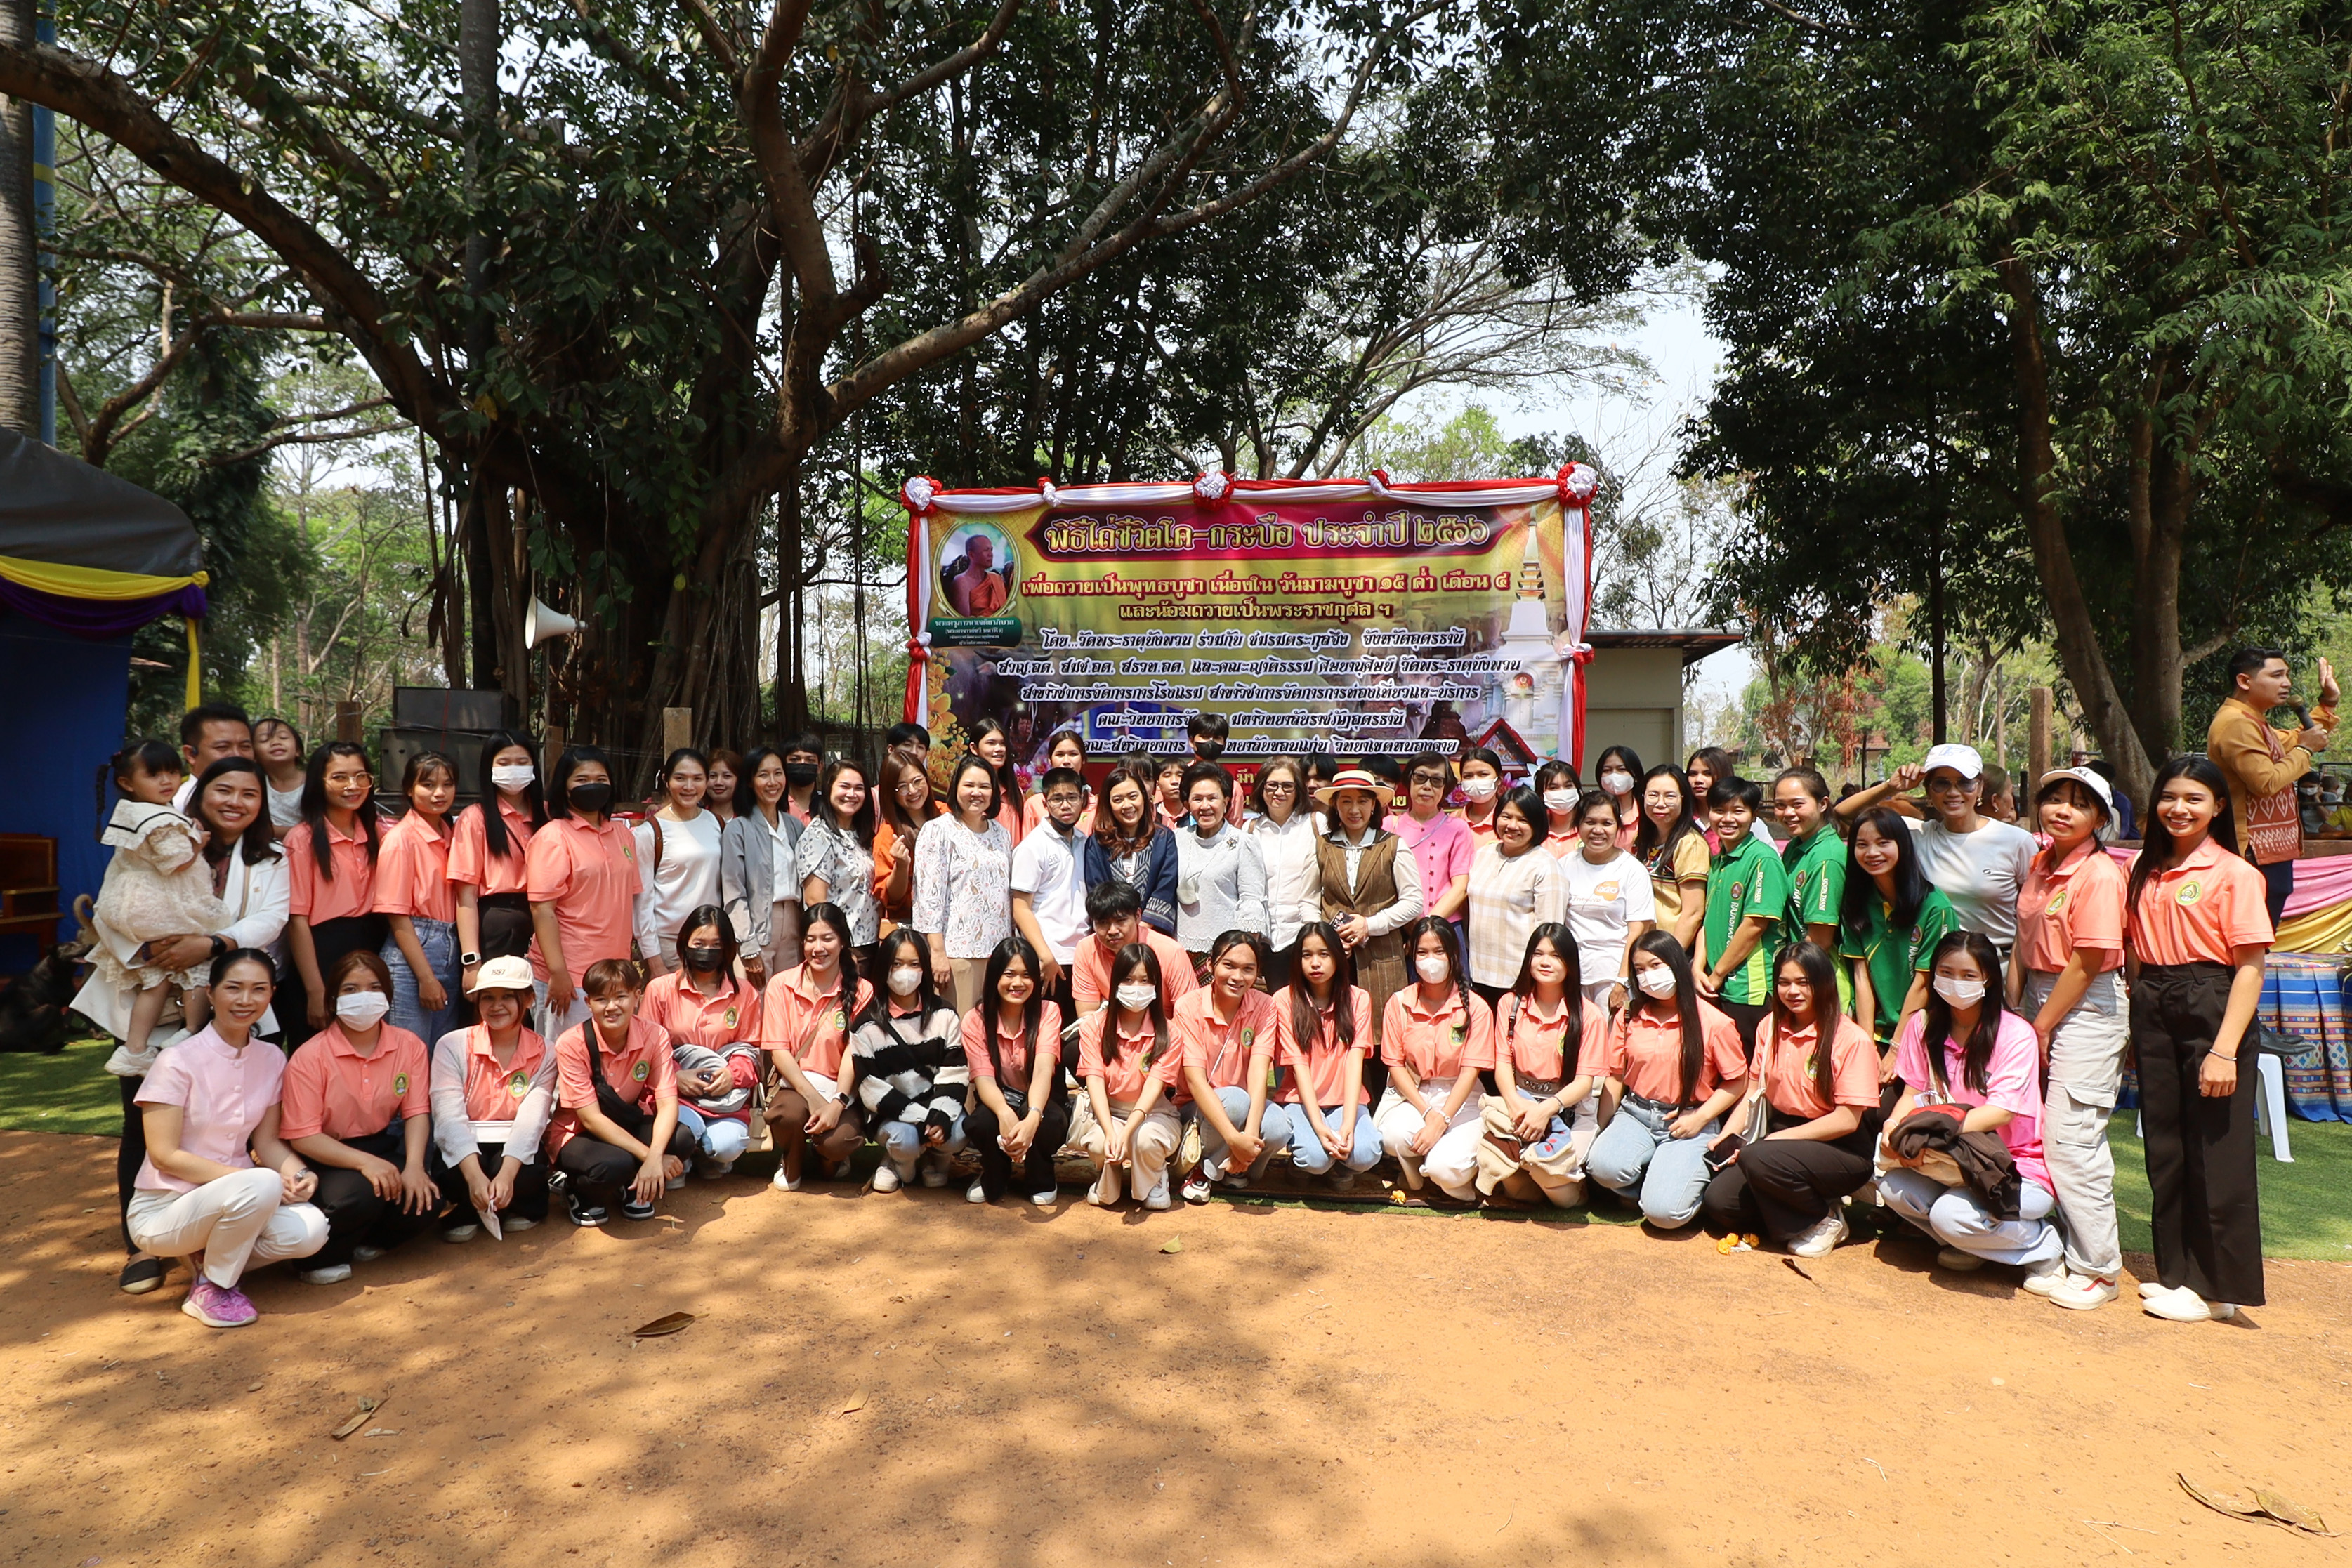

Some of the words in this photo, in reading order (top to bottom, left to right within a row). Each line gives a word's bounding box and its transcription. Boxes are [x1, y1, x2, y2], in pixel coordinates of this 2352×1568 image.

[1046, 515, 1293, 550] พิธีไถ่ชีวิตโค-กระบือ
[1303, 513, 1408, 547] ประจำปี
[1415, 515, 1489, 546] ๒๕๖๖
[1022, 573, 1203, 598] เพื่อถวายเป็นพุทธบูชา
[1211, 571, 1273, 593] เนื่องใน
[1379, 573, 1405, 591] ๑๕
[1412, 567, 1434, 590] ค่ำ
[1443, 570, 1489, 590] เดือน
[1121, 598, 1371, 622] และน้อมถวายเป็นพระราชกุศล
[1379, 604, 1391, 617] ฯ
[1197, 630, 1242, 647] ร่วมกับ
[1363, 628, 1465, 648] จังหวัดอุดรธานี
[1191, 657, 1313, 675] และคณะญาติธรรม
[1318, 655, 1395, 676] ศิษยานุศิษย์
[1401, 656, 1520, 675] วัดพระธาตุบังพวน
[1023, 681, 1203, 700] สาขาวิชาการจัดการการโรงแรม
[1209, 680, 1478, 700] สาขาวิชาการจัดการการท่องเที่ยวและบริการ
[1231, 709, 1404, 730] มหาวิทยาลัยราชภัฏอุดรธานี
